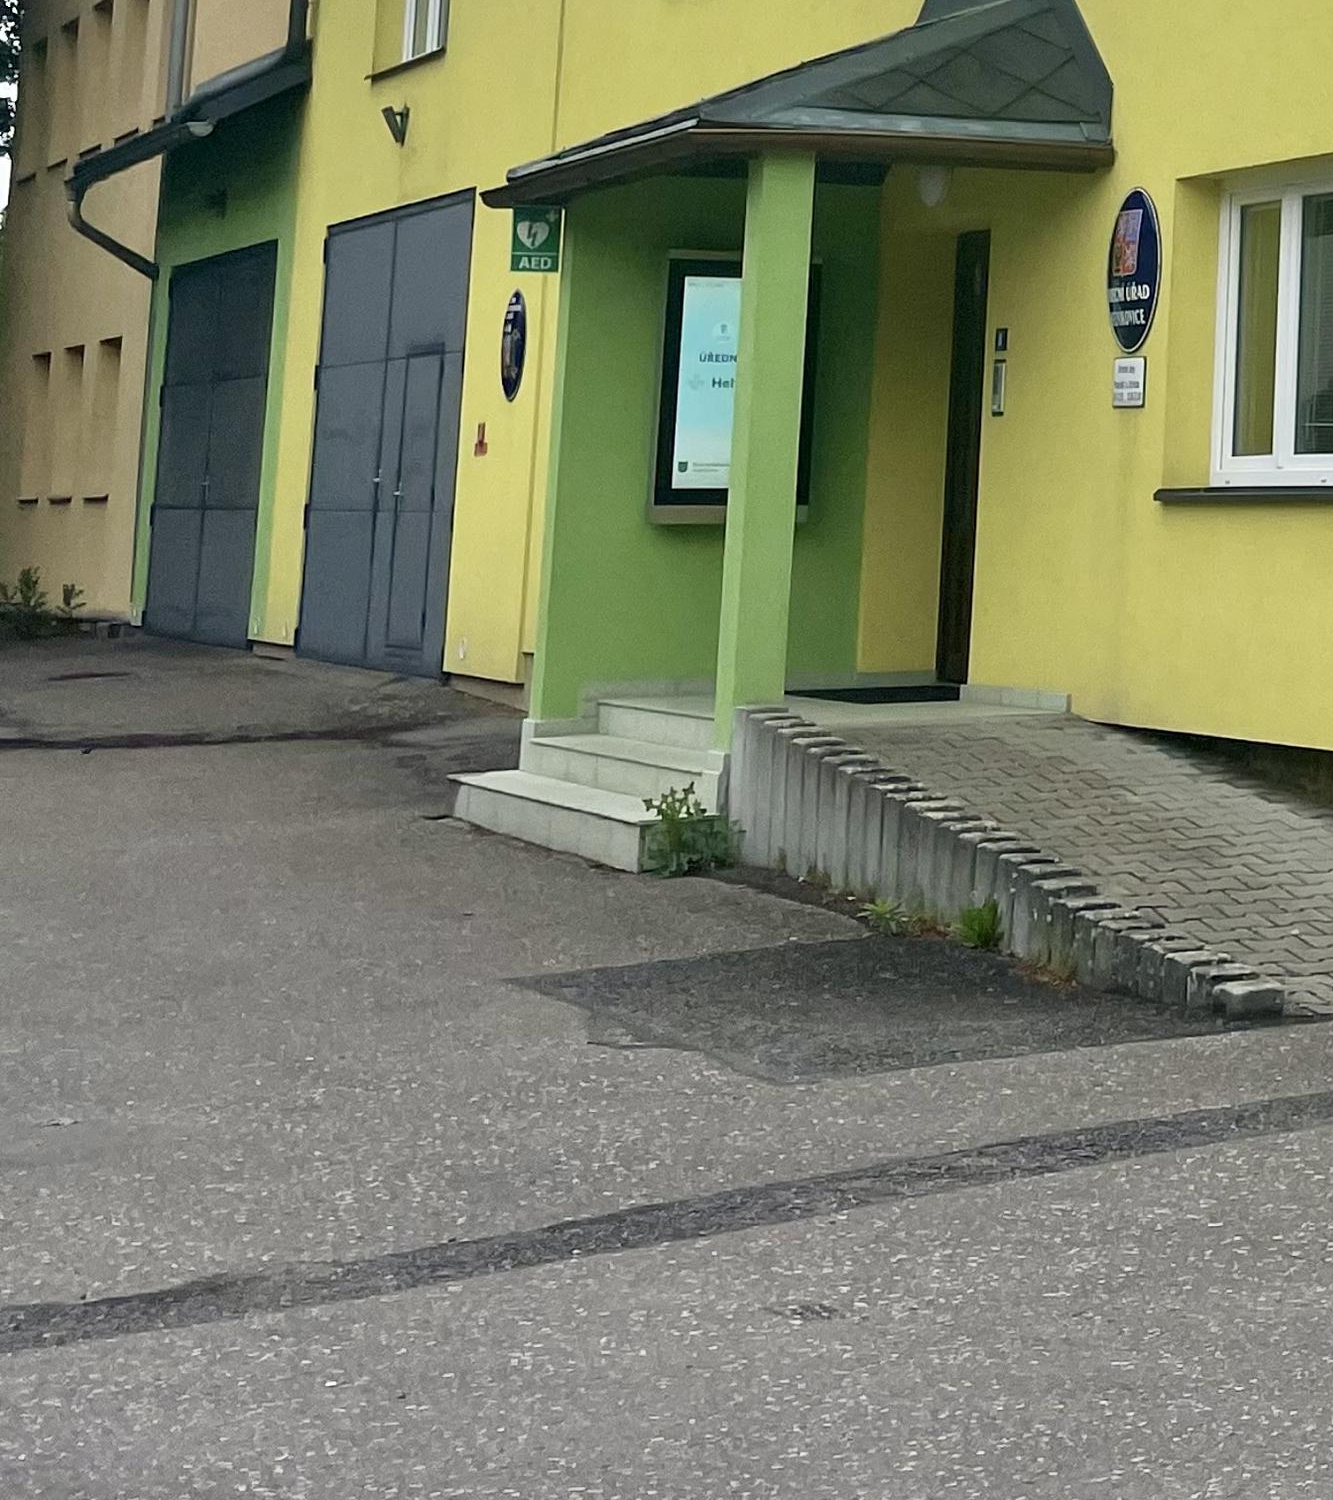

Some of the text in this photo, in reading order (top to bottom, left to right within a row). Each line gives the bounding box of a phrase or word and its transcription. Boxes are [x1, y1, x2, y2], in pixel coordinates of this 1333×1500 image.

[518, 256, 551, 270] AED
[1126, 281, 1150, 301] ÚŘAD
[699, 351, 738, 363] ÚŘEDN
